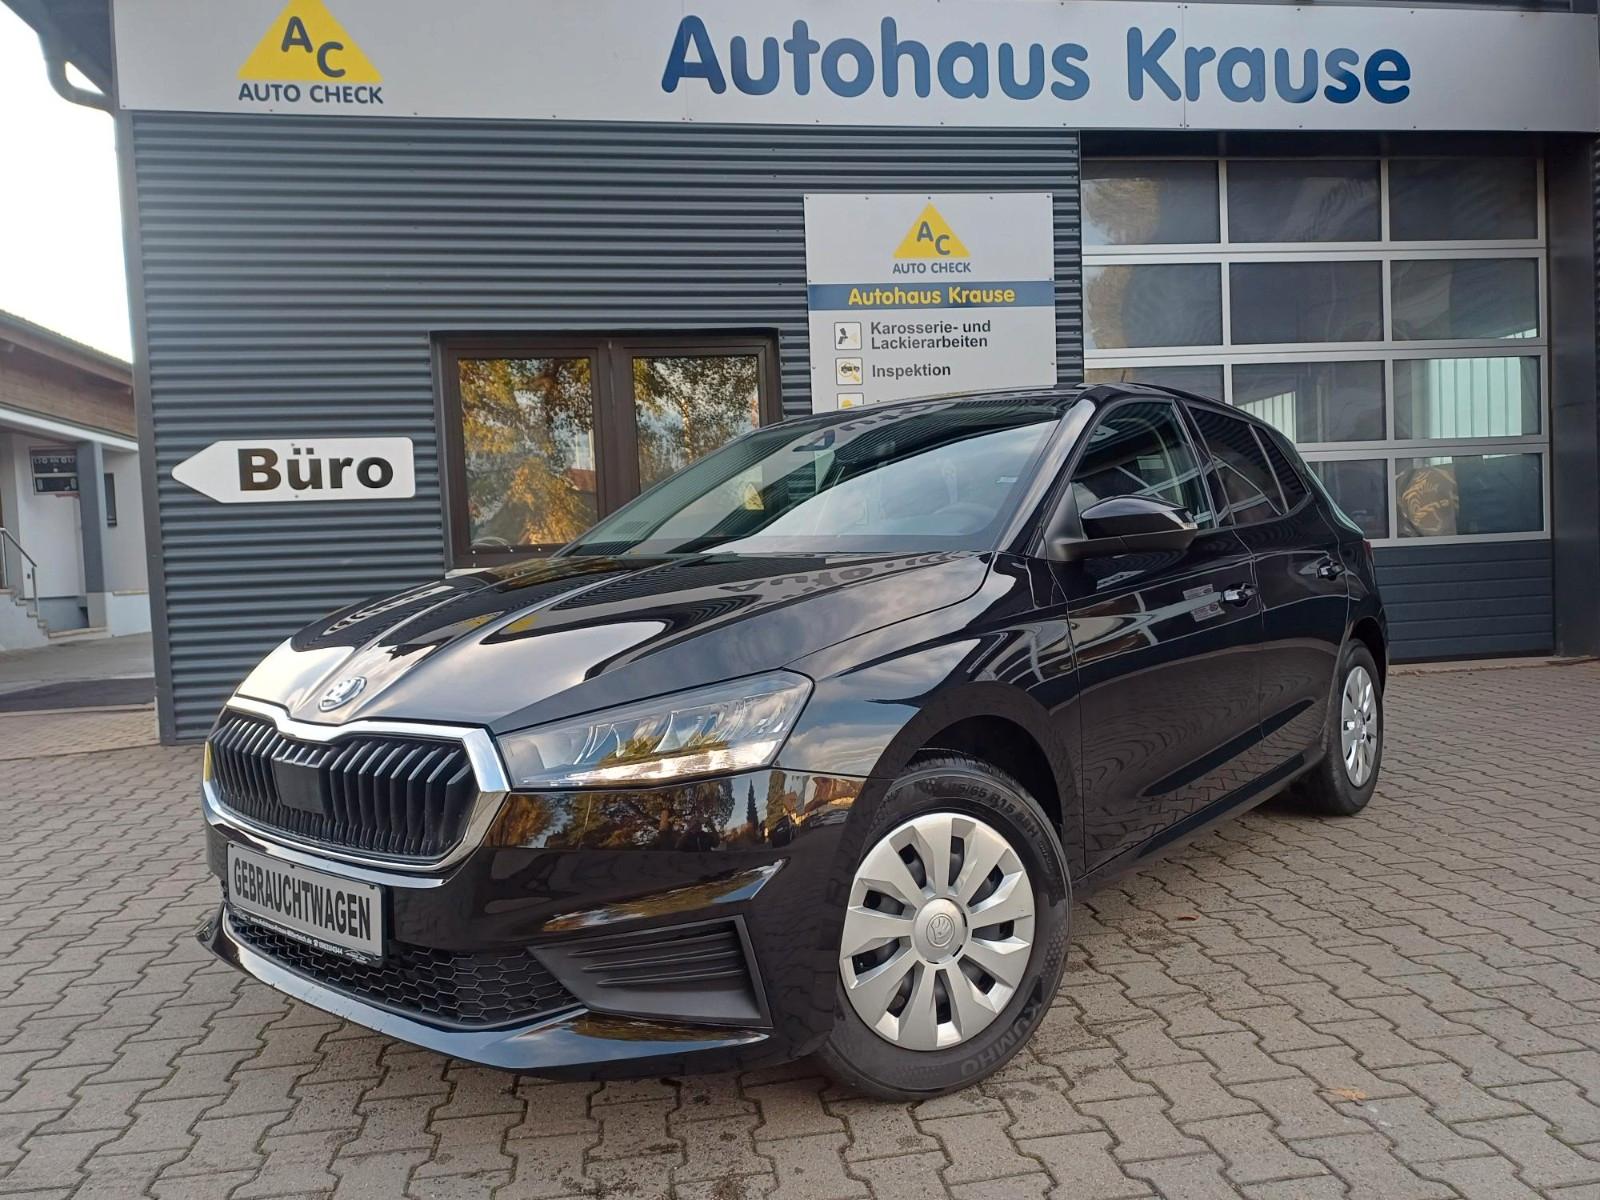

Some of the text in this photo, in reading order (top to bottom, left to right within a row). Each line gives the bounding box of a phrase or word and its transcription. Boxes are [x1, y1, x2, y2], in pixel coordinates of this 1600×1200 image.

[661, 15, 1411, 104] Autohaus Krause
[238, 82, 384, 105] AUTO CHECK
[892, 261, 972, 275] AUTO CHECK
[848, 286, 1016, 306] Autohaus Krause
[870, 319, 992, 336] Karosserie- und
[871, 334, 988, 350] Lackierarbeiten
[871, 363, 951, 380] Inspektion
[237, 447, 394, 492] Büro
[234, 857, 371, 941] GEBRAUCHTWAGEN
[961, 974, 1042, 1076] KUMHO
